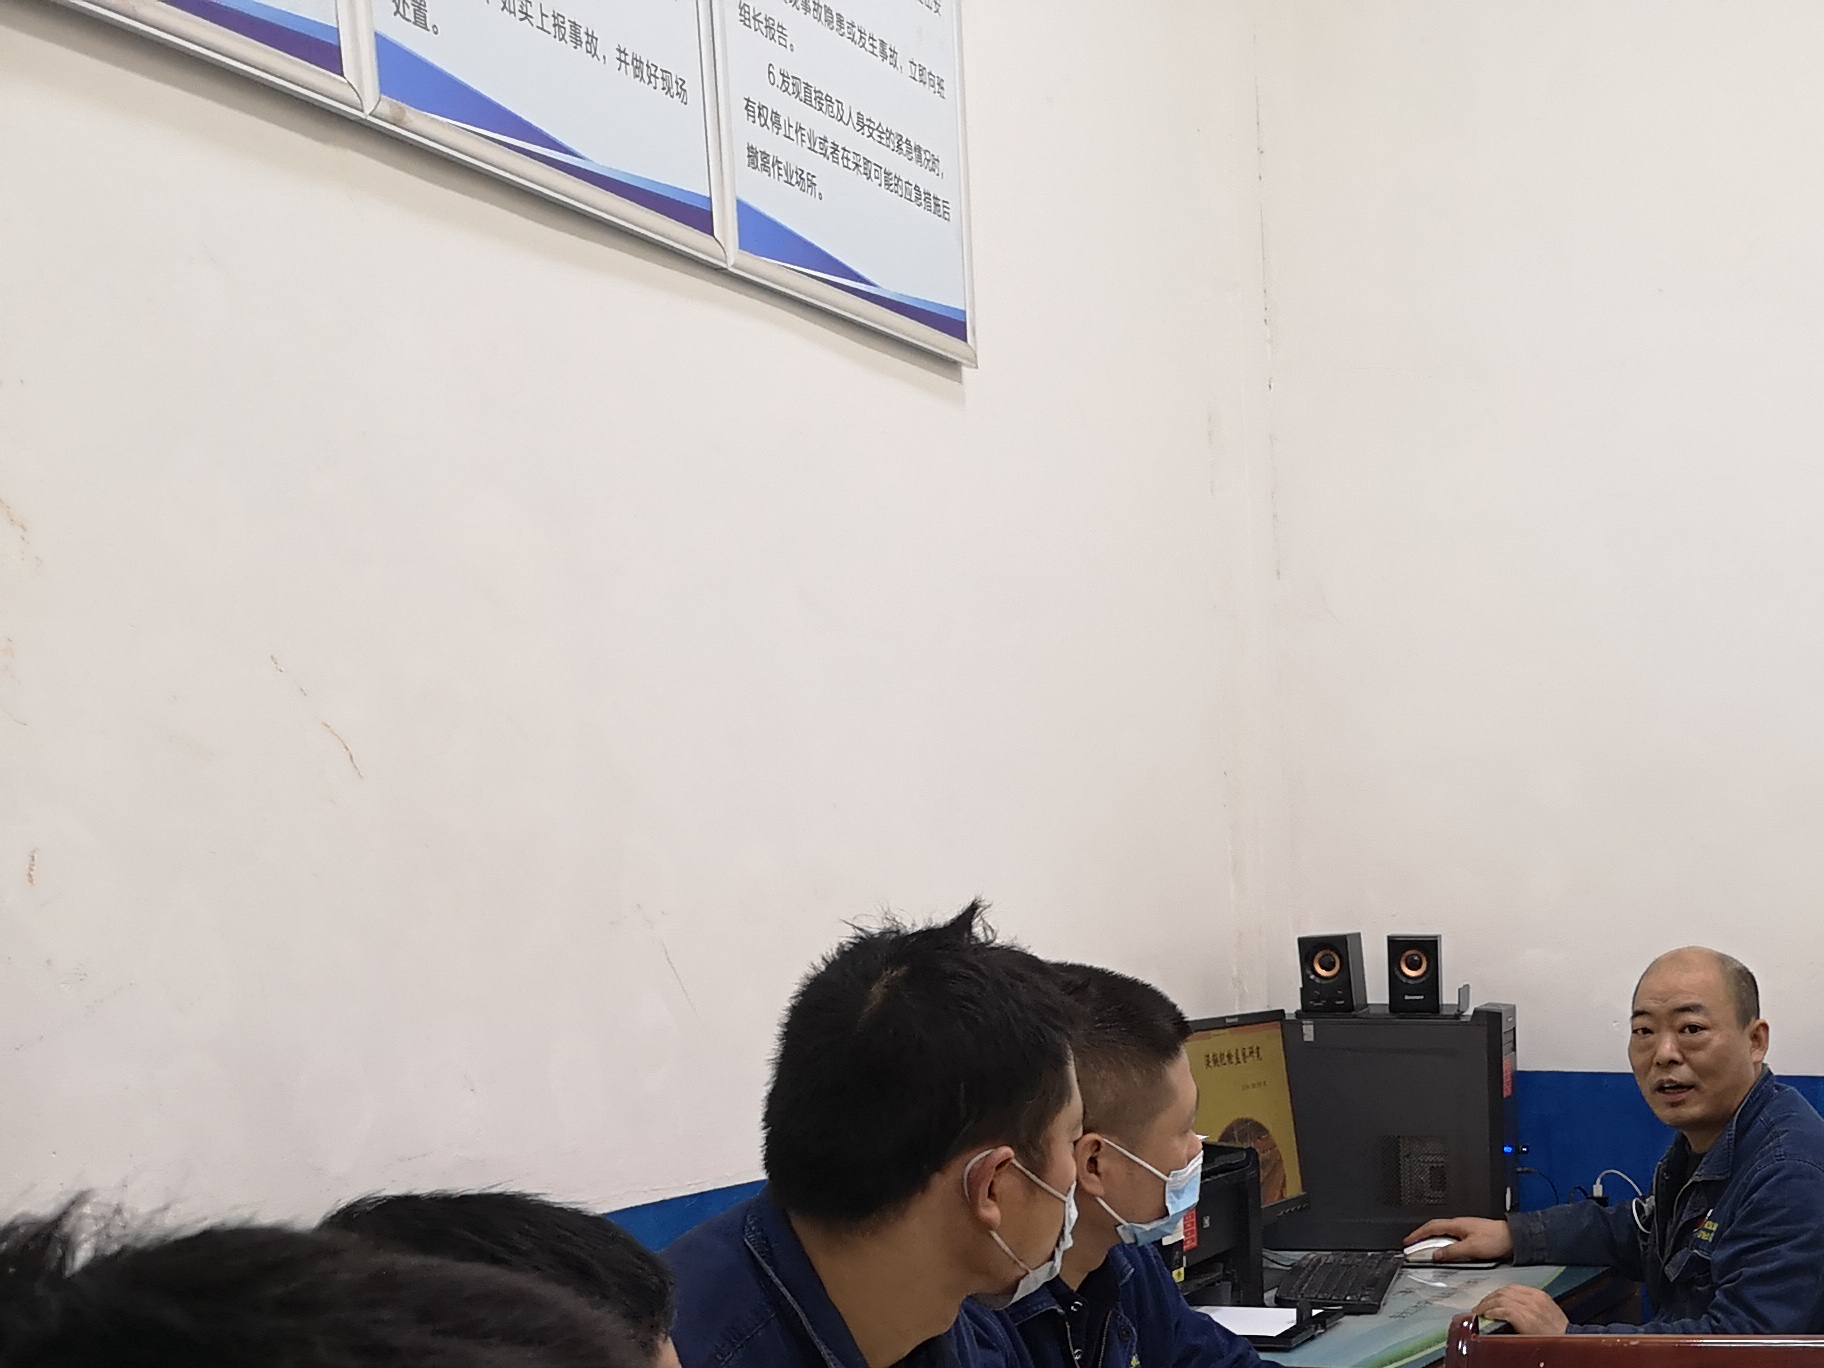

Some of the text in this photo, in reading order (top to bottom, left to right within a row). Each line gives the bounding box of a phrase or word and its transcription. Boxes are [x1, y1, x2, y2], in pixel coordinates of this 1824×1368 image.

[738, 0, 795, 52] 组长报告。
[743, 96, 951, 222] 有权停止作业或者在采取可能的应急措施后
[746, 142, 823, 200] 撤离作业场所。
